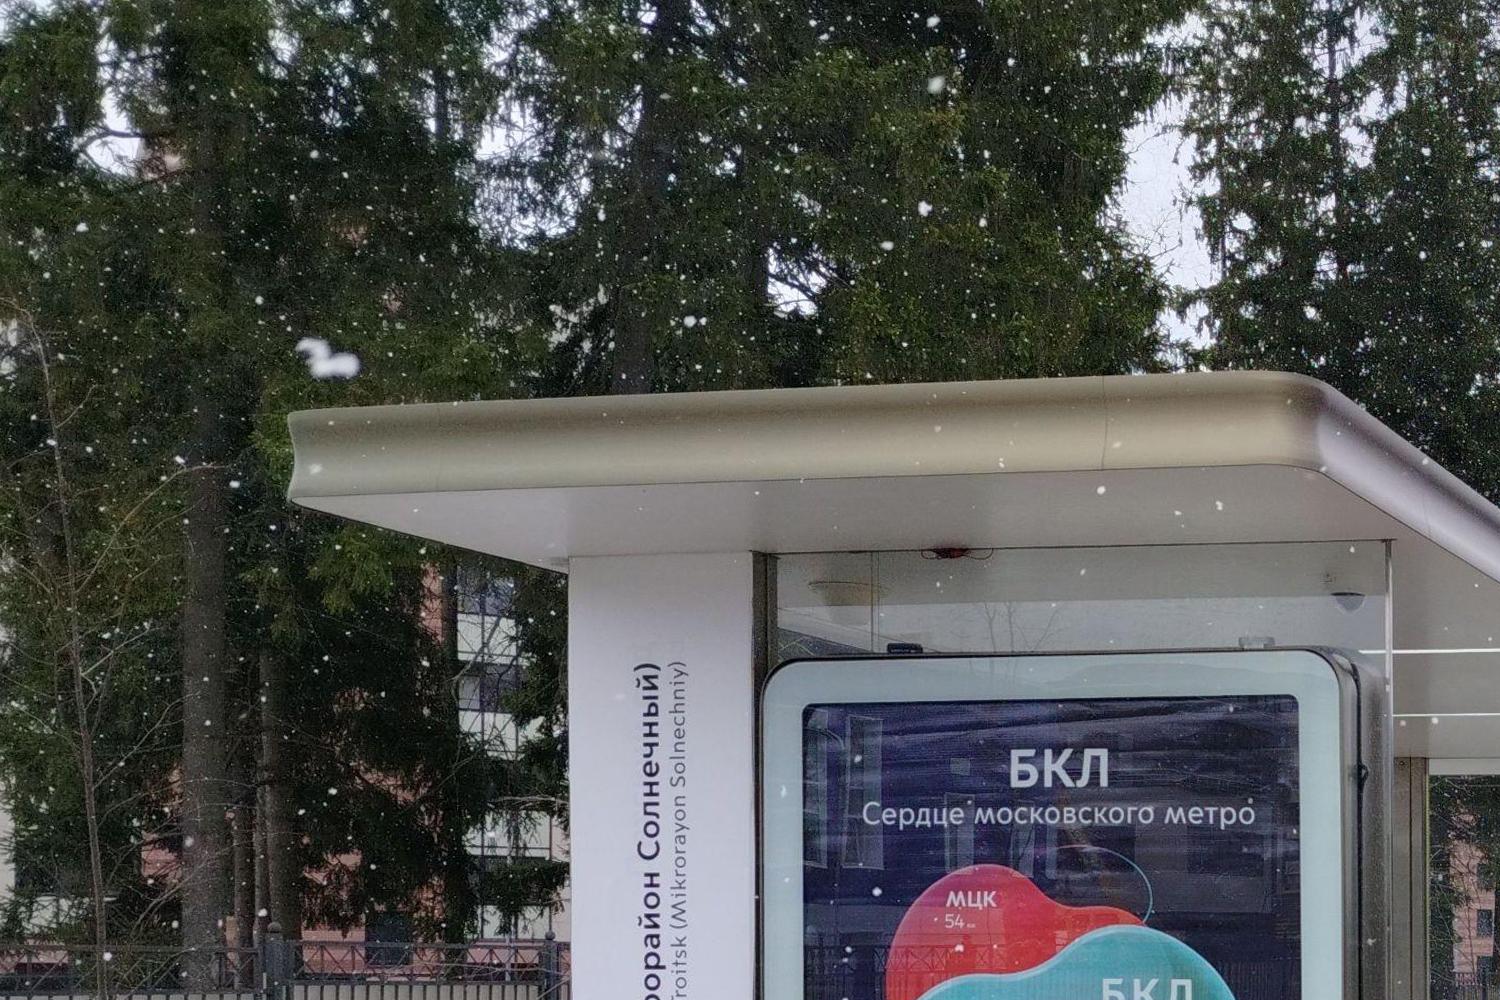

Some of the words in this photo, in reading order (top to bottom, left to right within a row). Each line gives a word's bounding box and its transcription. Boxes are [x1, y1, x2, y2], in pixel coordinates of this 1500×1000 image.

[668, 661, 687, 788] Solnechniy)
[634, 662, 662, 861] Солнечный)
[1010, 748, 1109, 788] БКЛ
[862, 801, 965, 830] Сердце
[974, 806, 1155, 825] московского
[1164, 806, 1256, 830] метро
[669, 795, 689, 930] (Mikrorayon
[946, 890, 997, 910] МЦК
[945, 913, 965, 928] 54
